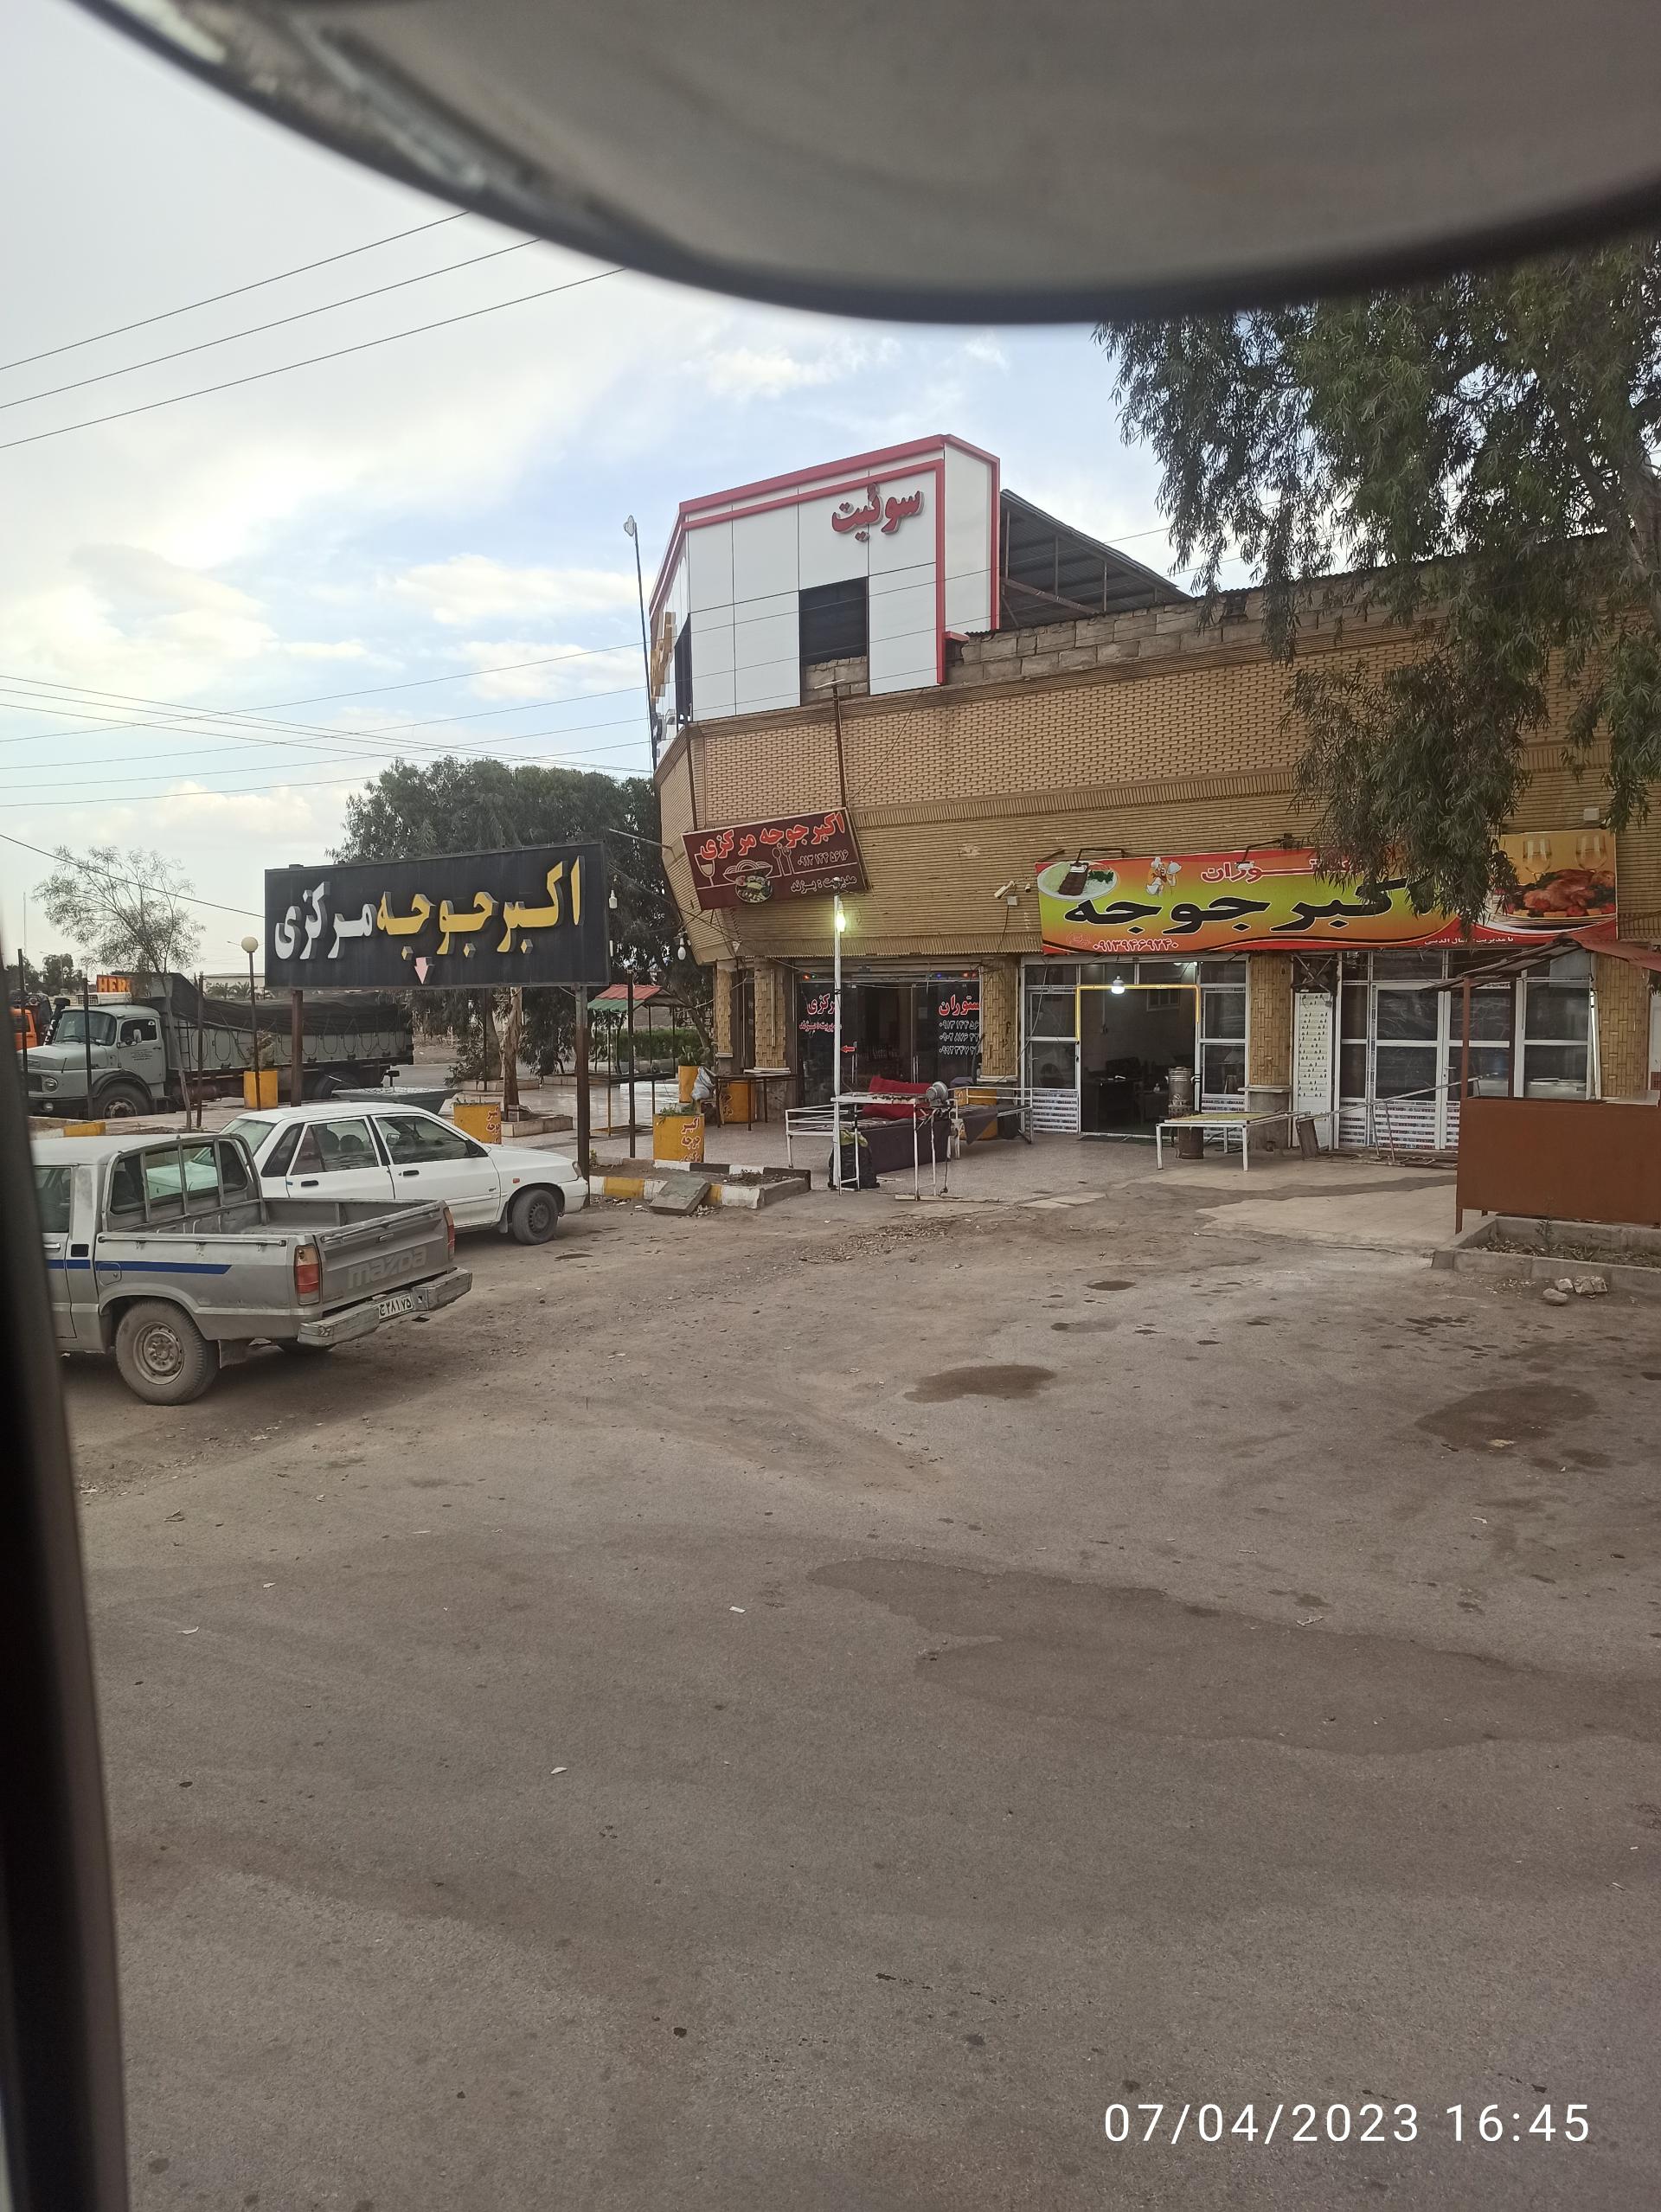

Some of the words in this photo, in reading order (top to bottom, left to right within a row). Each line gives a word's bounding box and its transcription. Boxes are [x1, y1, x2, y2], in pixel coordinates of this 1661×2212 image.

[700, 829, 757, 860] مرکزی
[760, 824, 809, 850] جوجه
[811, 811, 845, 845] اکبر
[274, 881, 377, 961] مرکزی
[497, 855, 585, 955] اکبر
[1064, 894, 1272, 935] جوجه
[376, 890, 499, 961] جوجه
[807, 993, 836, 1015] رکزی
[939, 994, 980, 1016] ستوران
